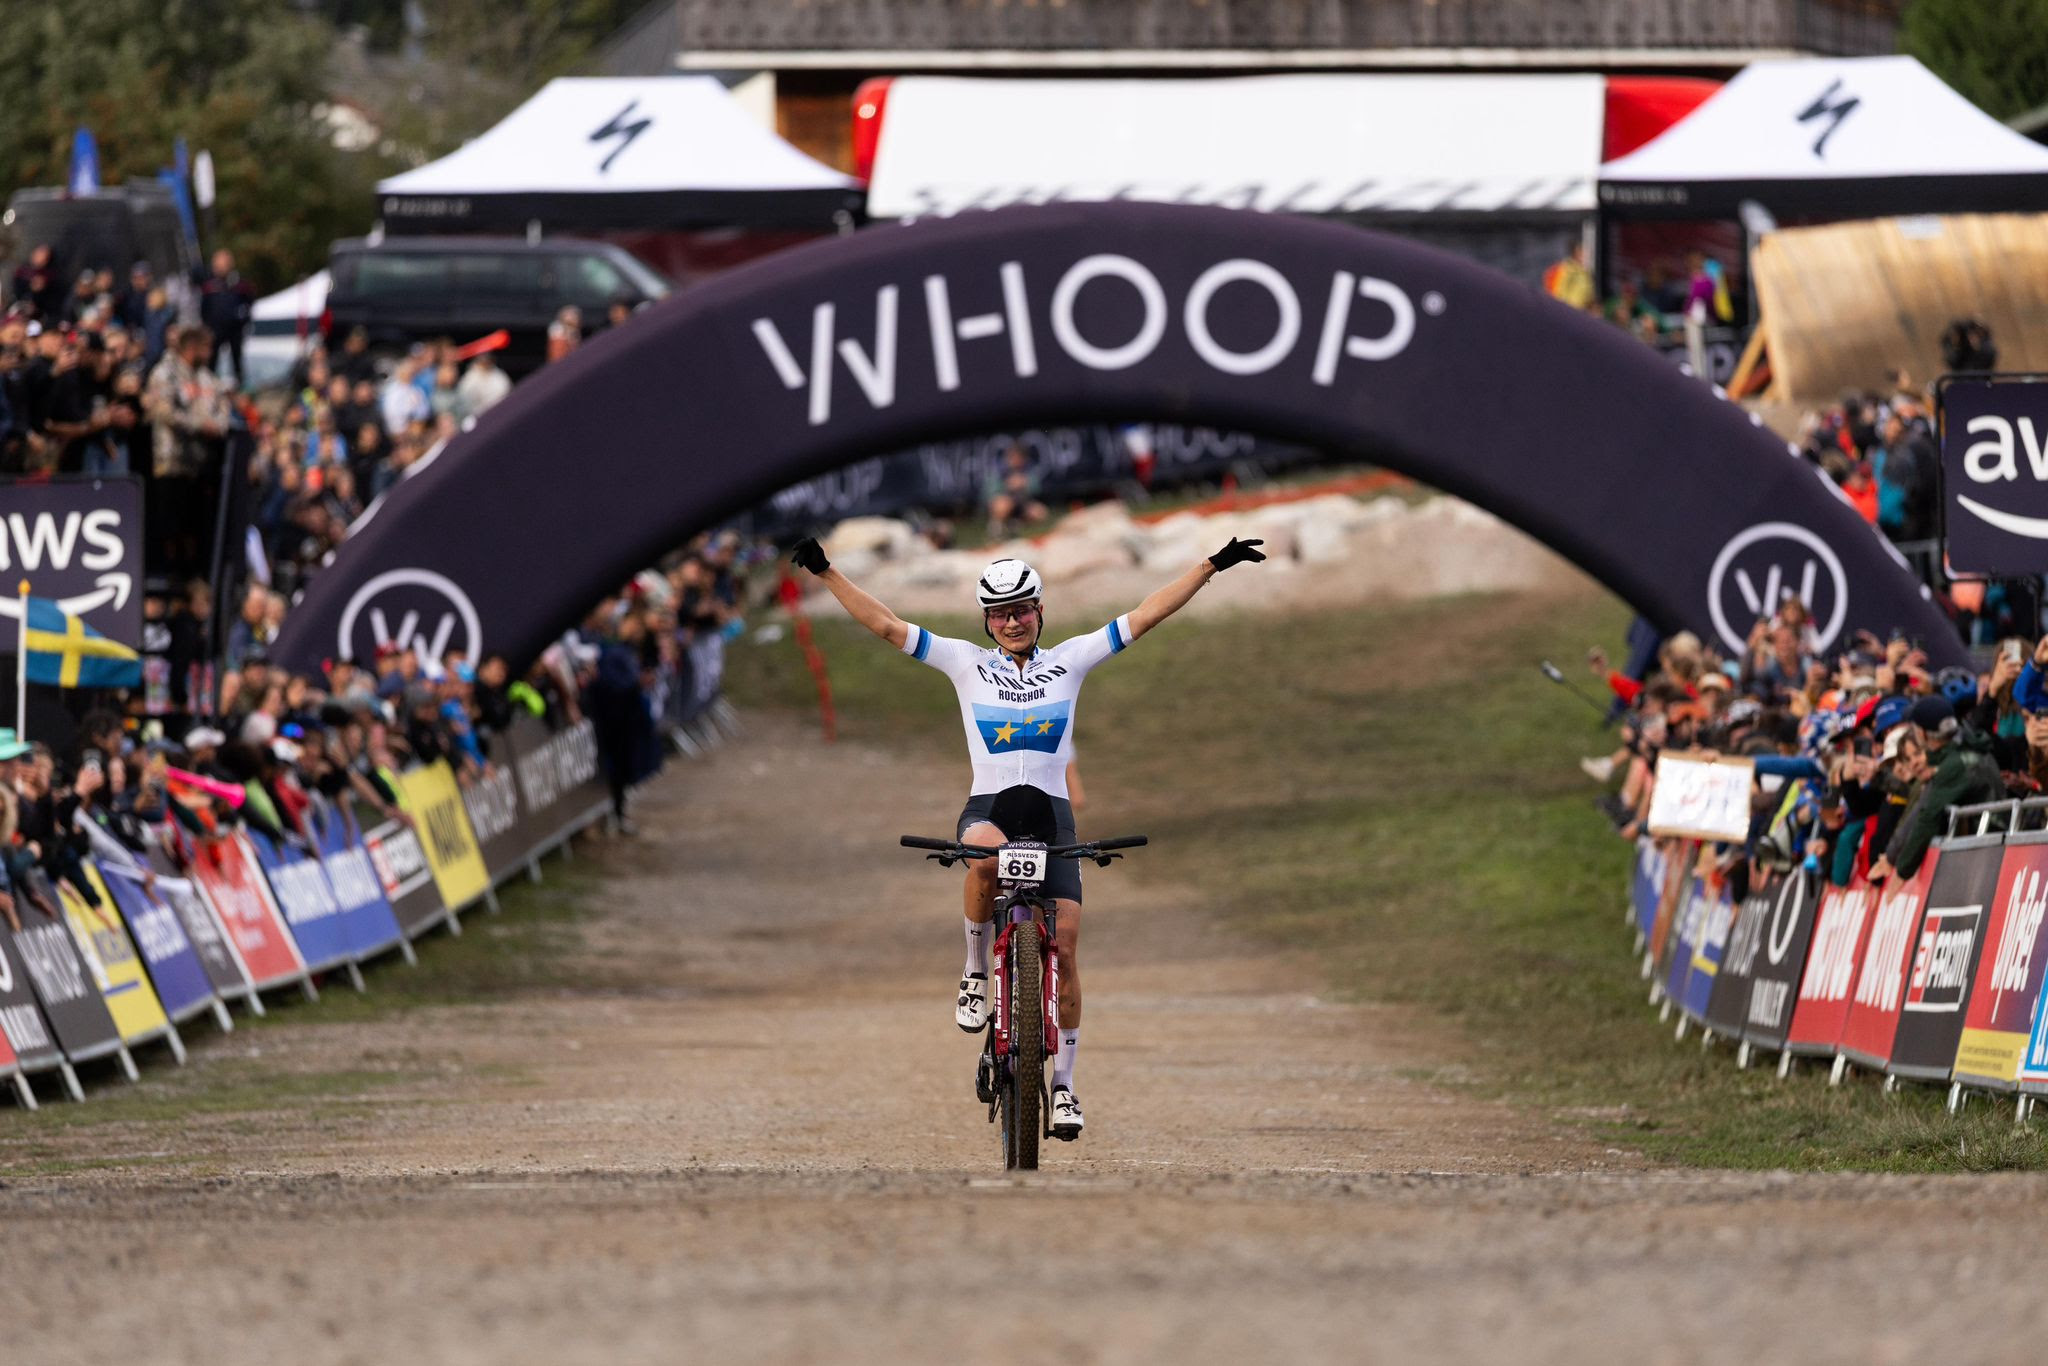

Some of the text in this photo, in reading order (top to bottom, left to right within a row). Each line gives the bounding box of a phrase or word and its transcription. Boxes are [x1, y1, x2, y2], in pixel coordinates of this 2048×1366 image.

[752, 253, 1416, 425] WHOOP
[0, 508, 124, 572] ws
[977, 664, 1068, 690] CANYON
[998, 687, 1045, 703] ROCKSHOX
[1008, 859, 1036, 878] 69
